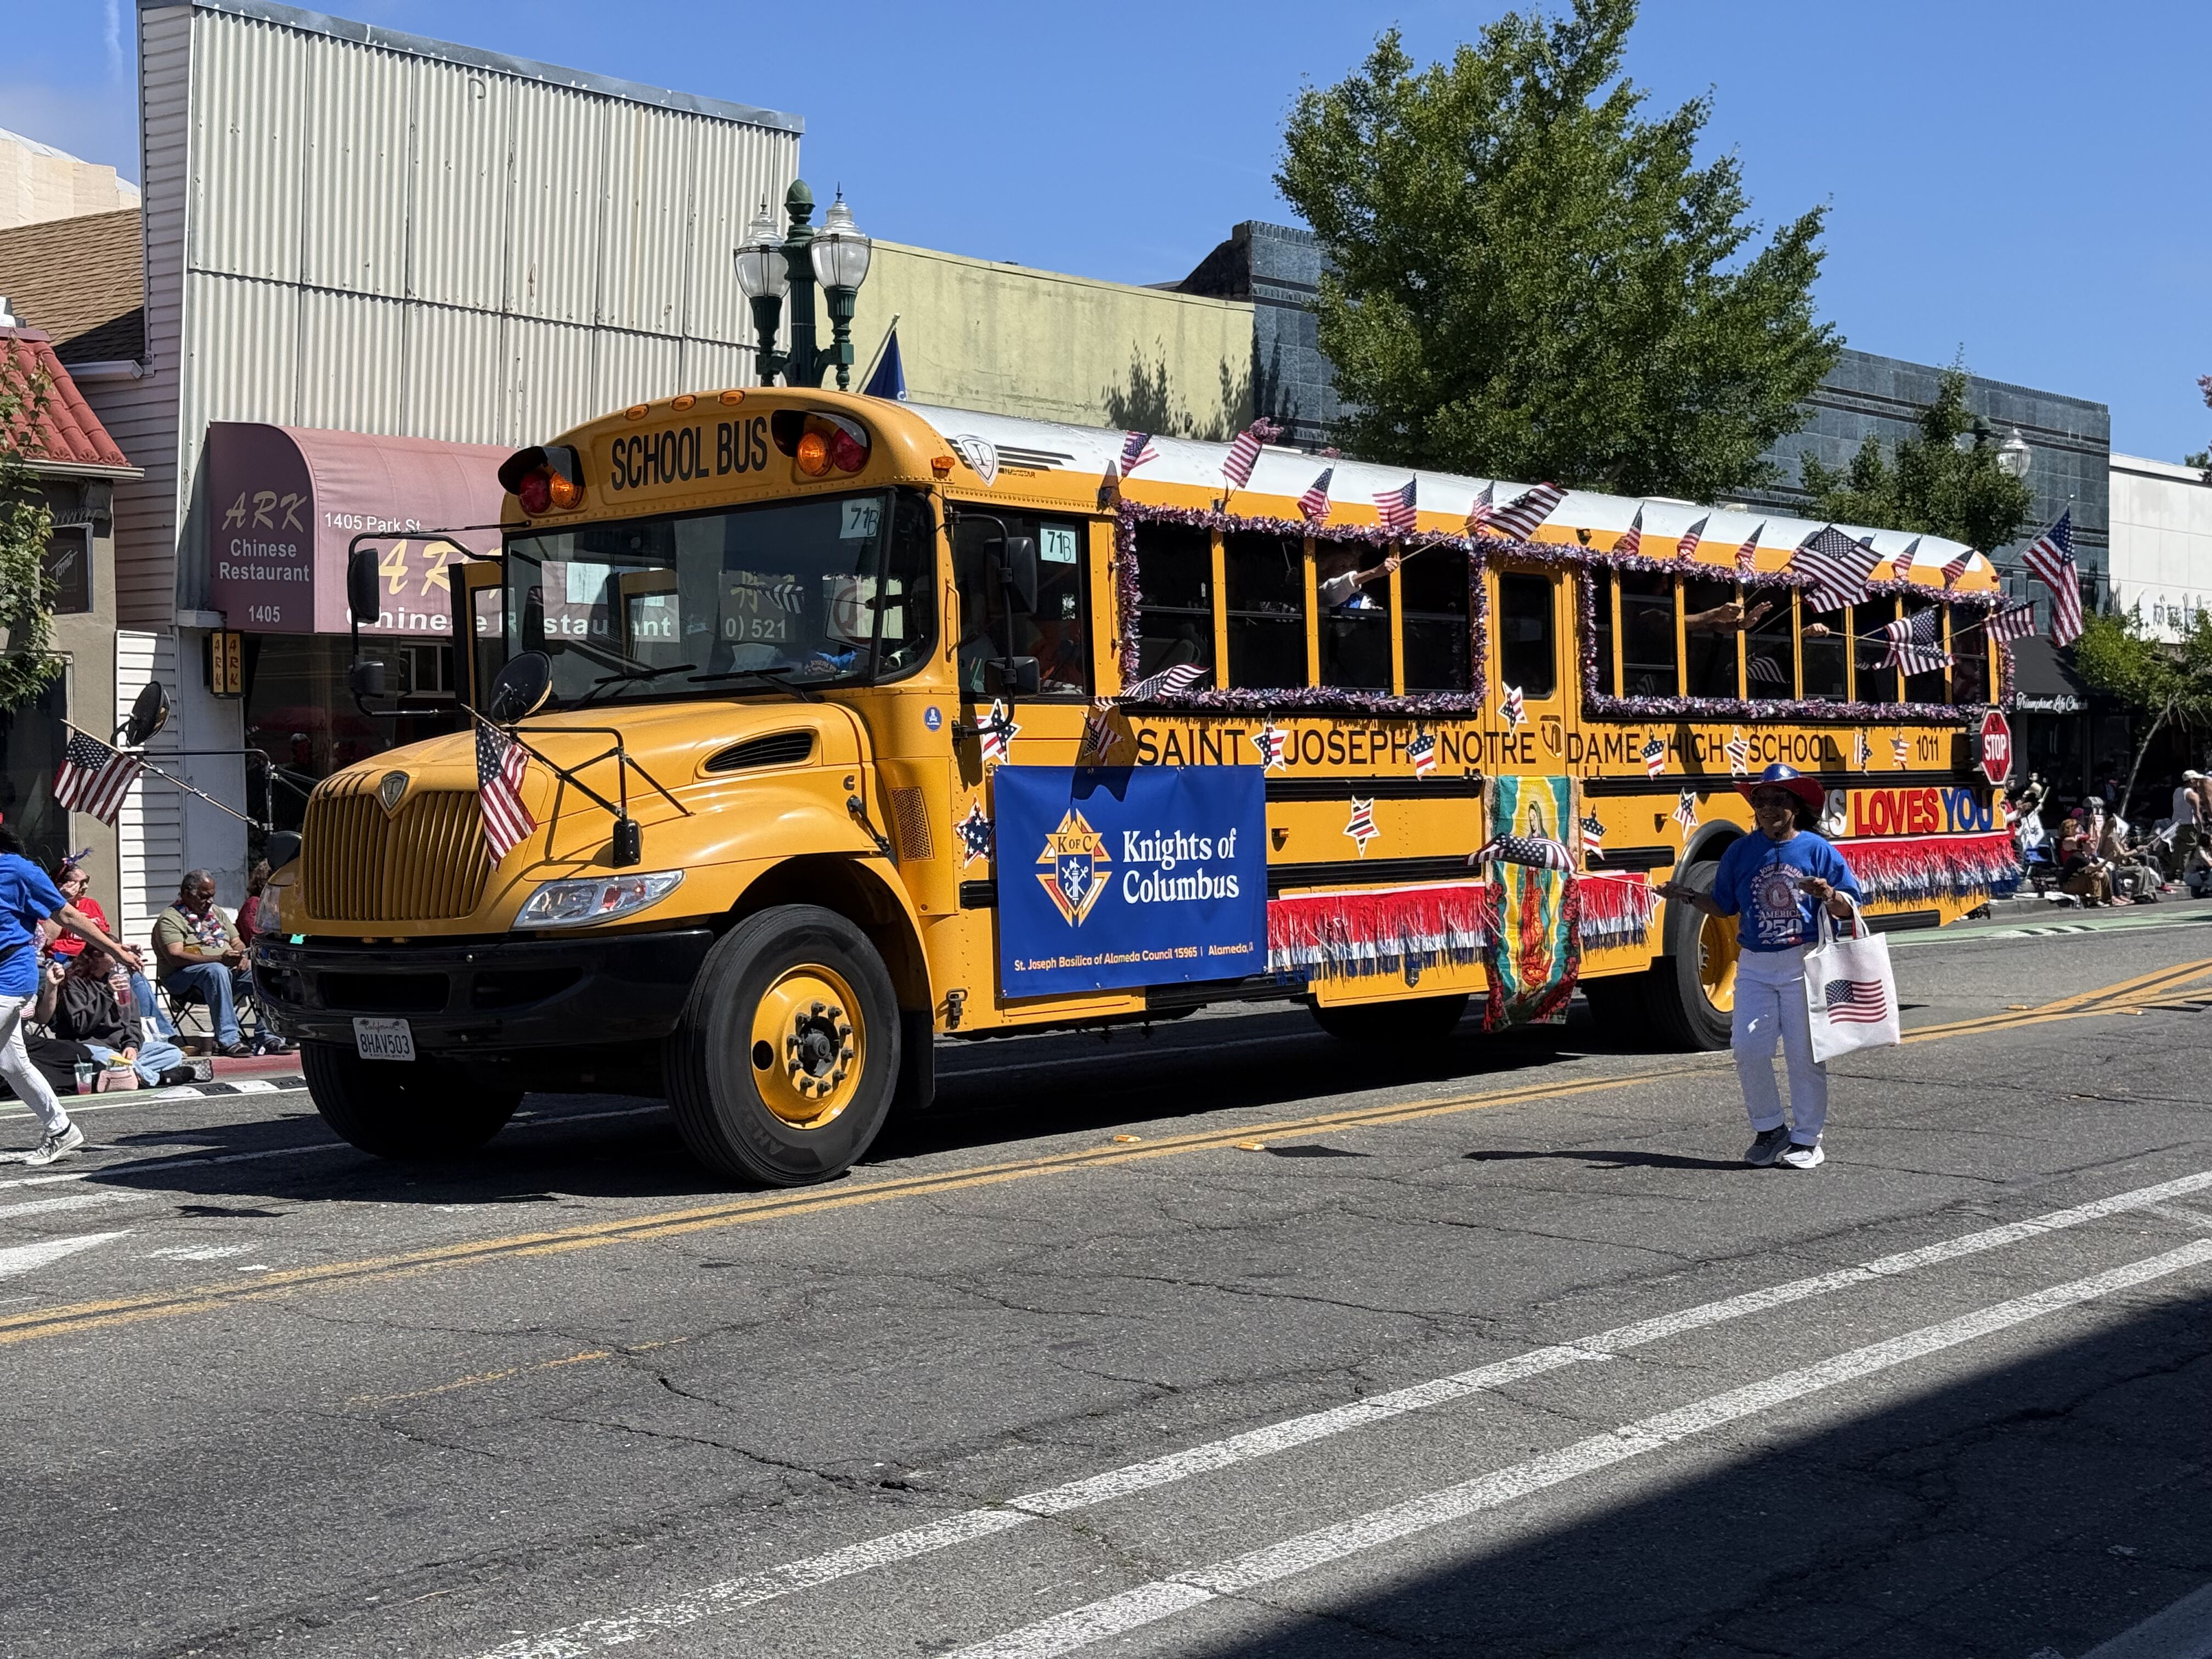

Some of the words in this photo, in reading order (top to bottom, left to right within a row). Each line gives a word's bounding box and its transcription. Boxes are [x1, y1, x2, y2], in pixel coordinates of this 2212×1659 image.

[611, 427, 709, 490] SCHOOL
[716, 416, 768, 475] BUS
[222, 491, 307, 533] ARK
[325, 512, 363, 530] 1405
[367, 516, 402, 532] Park
[405, 519, 421, 531] St
[230, 538, 297, 557] Chinese
[1047, 531, 1071, 561] 71B
[219, 561, 309, 582] Restaurant
[249, 605, 280, 623] 1405
[229, 639, 239, 686] ARK
[1137, 729, 1245, 765] SAINT
[1284, 729, 1412, 765] JOSEPH
[1441, 730, 1536, 764] NOTRE
[1567, 732, 1641, 764] DAME
[1667, 732, 1724, 764] HIGH
[1748, 733, 1837, 763] SCHOOL
[1916, 735, 1940, 761] 1011
[1984, 733, 2007, 761] STOP
[1854, 788, 1939, 836] LOVES
[1941, 787, 1993, 832] YOU
[1058, 836, 1067, 853] K
[1069, 838, 1081, 849] OF
[1082, 836, 1093, 851] C
[1122, 830, 1212, 870] Knights
[1218, 828, 1237, 859] of
[1123, 867, 1239, 904] Columbus
[1758, 919, 1803, 938] 250
[1759, 910, 1802, 920] AMERICA
[1014, 960, 1026, 971] St.
[1028, 957, 1057, 971] Joseph
[1059, 955, 1092, 968] Basilica
[1094, 953, 1103, 964] of
[1104, 951, 1141, 964] Alameda
[1142, 948, 1173, 961] Council
[1174, 946, 1198, 958] 15965
[1208, 943, 1249, 956] Alameda,
[360, 1034, 410, 1054] 8HAV503
